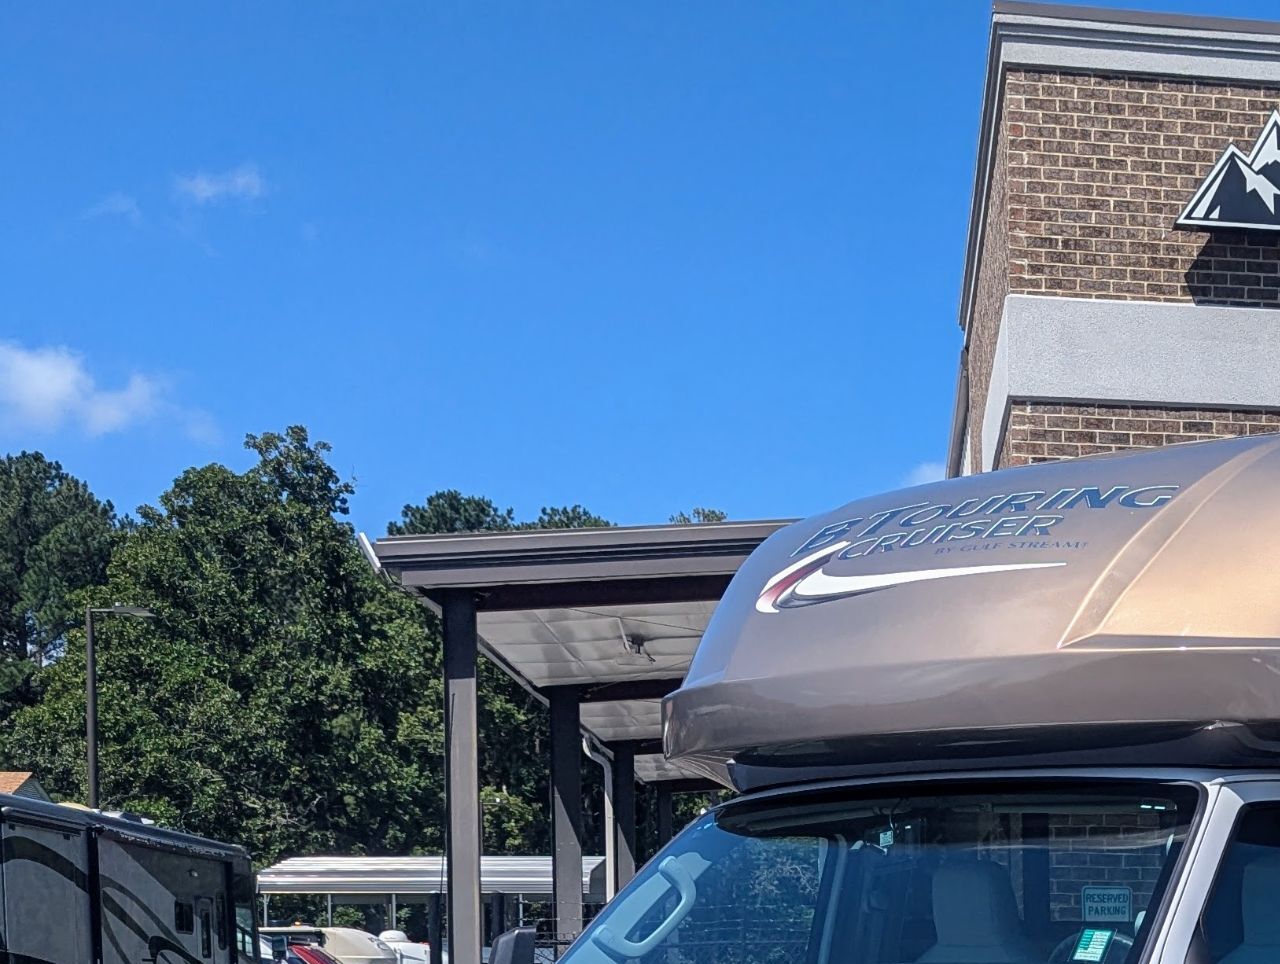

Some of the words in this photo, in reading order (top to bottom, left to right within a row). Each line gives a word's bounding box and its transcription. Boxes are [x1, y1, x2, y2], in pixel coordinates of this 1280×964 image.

[838, 514, 1064, 560] CRUISER
[1085, 893, 1129, 903] RESERVED
[1088, 906, 1127, 916] PARKING
